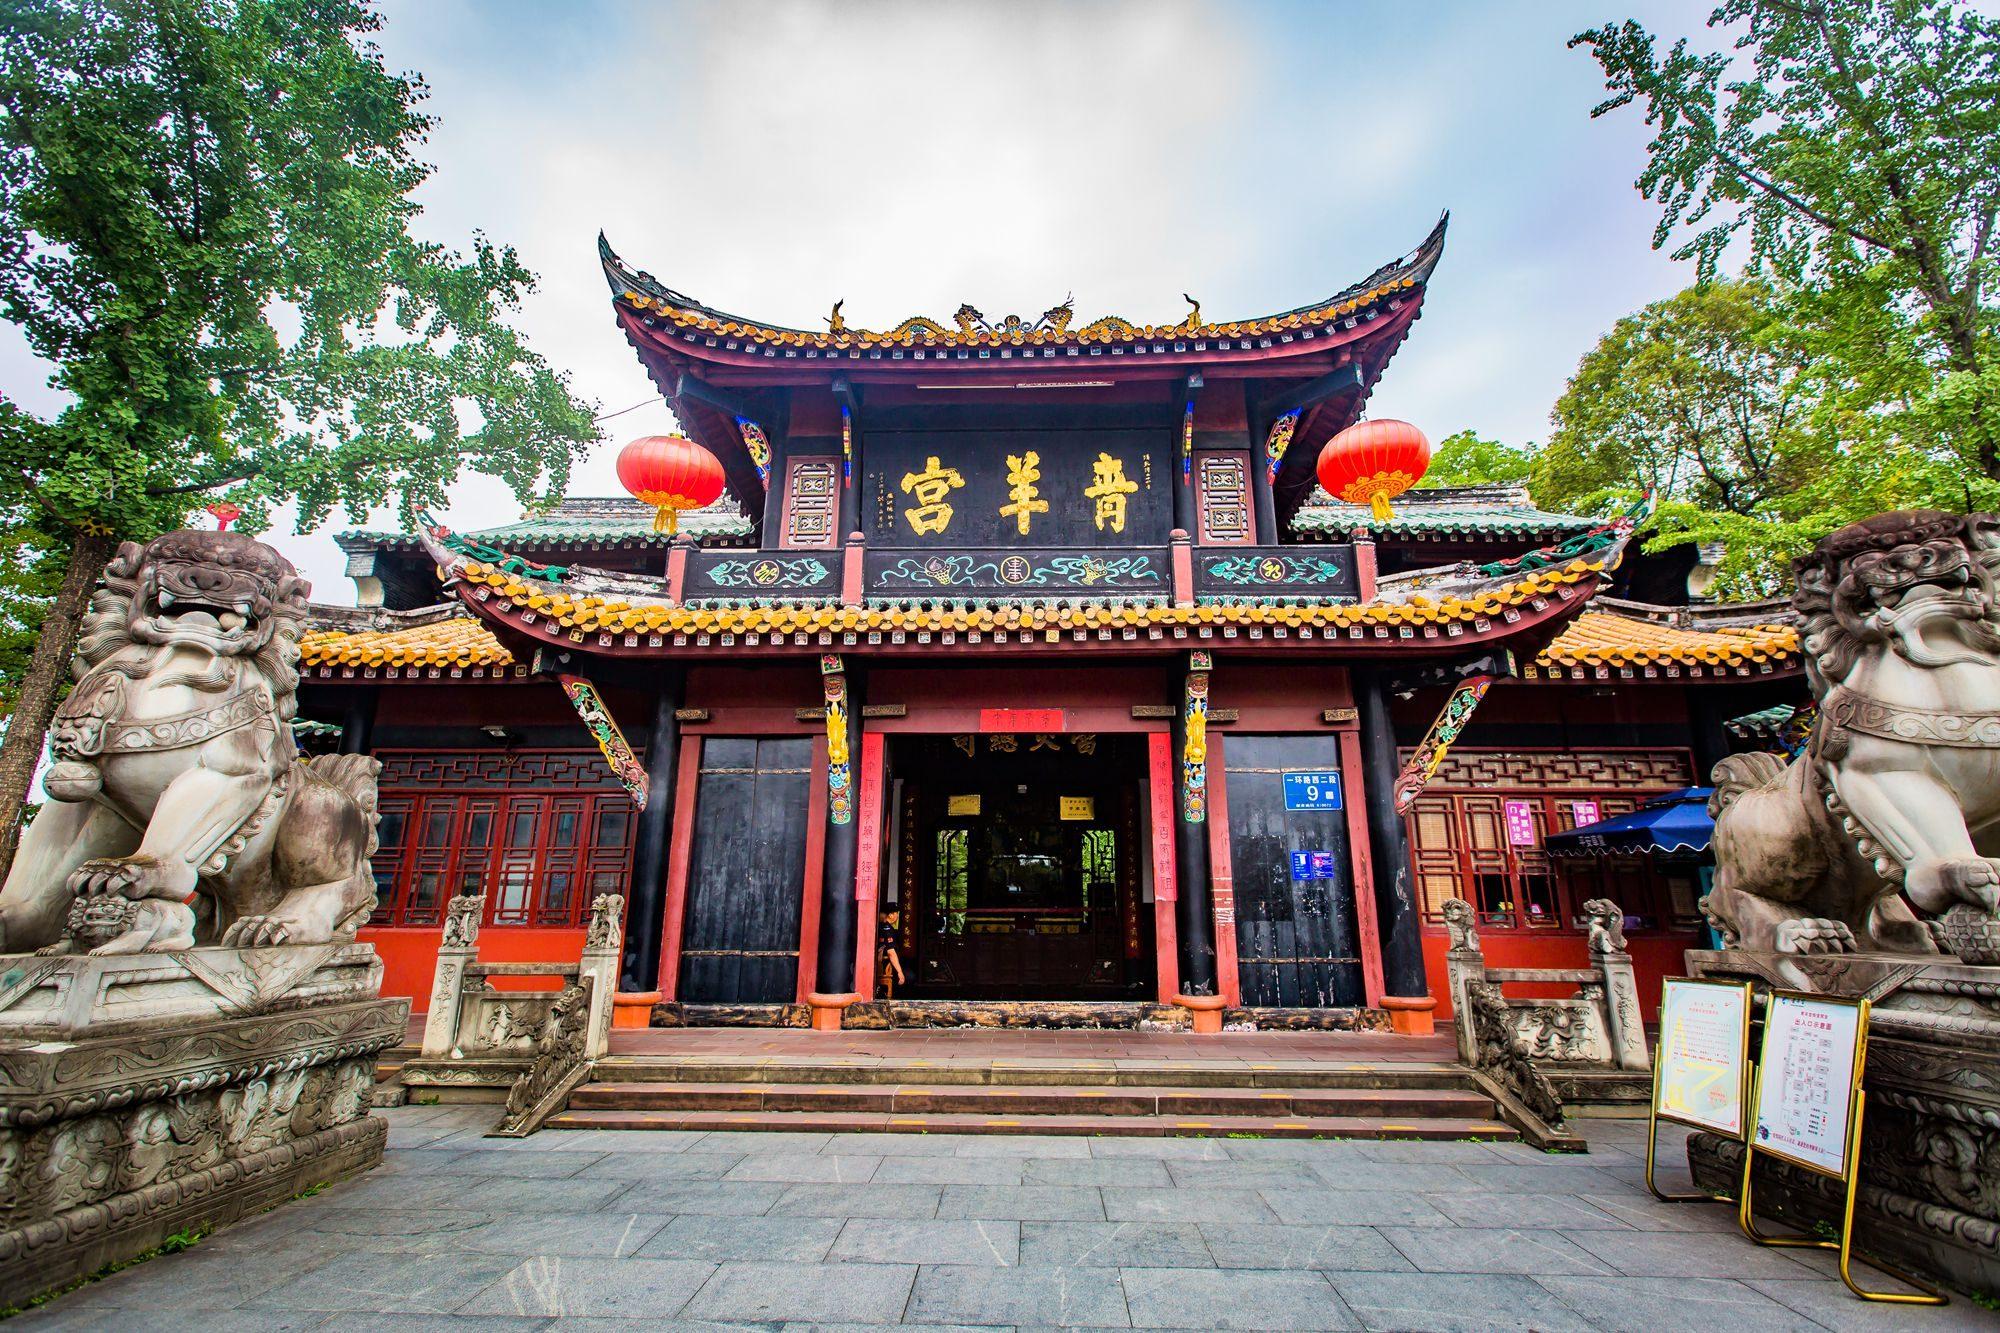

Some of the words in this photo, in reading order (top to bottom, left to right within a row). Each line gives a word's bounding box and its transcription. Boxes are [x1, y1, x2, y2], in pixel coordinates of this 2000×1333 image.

[1287, 776, 1336, 784] 一环路西二段
[1307, 786, 1318, 801] 9
